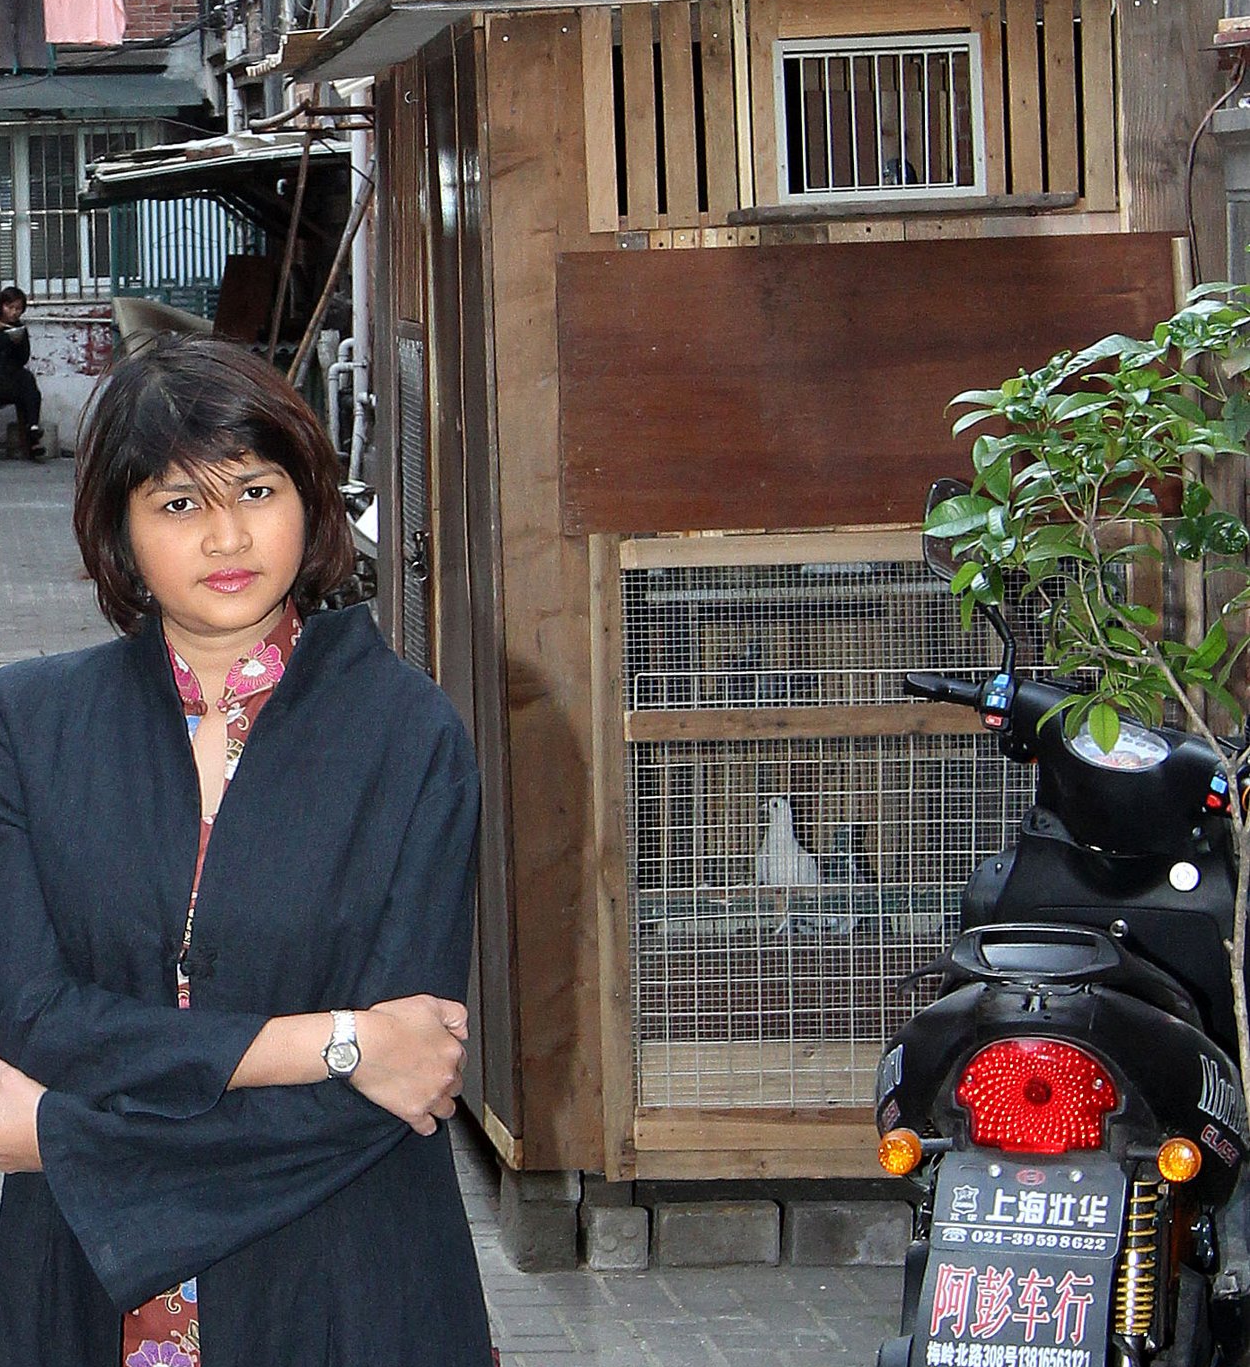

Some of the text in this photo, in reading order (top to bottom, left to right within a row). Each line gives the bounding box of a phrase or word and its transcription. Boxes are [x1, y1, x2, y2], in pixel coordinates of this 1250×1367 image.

[985, 1188, 1109, 1228] 上海壮华
[971, 1229, 1107, 1251] 021-39598622
[929, 1263, 1094, 1347] 阿彭车行
